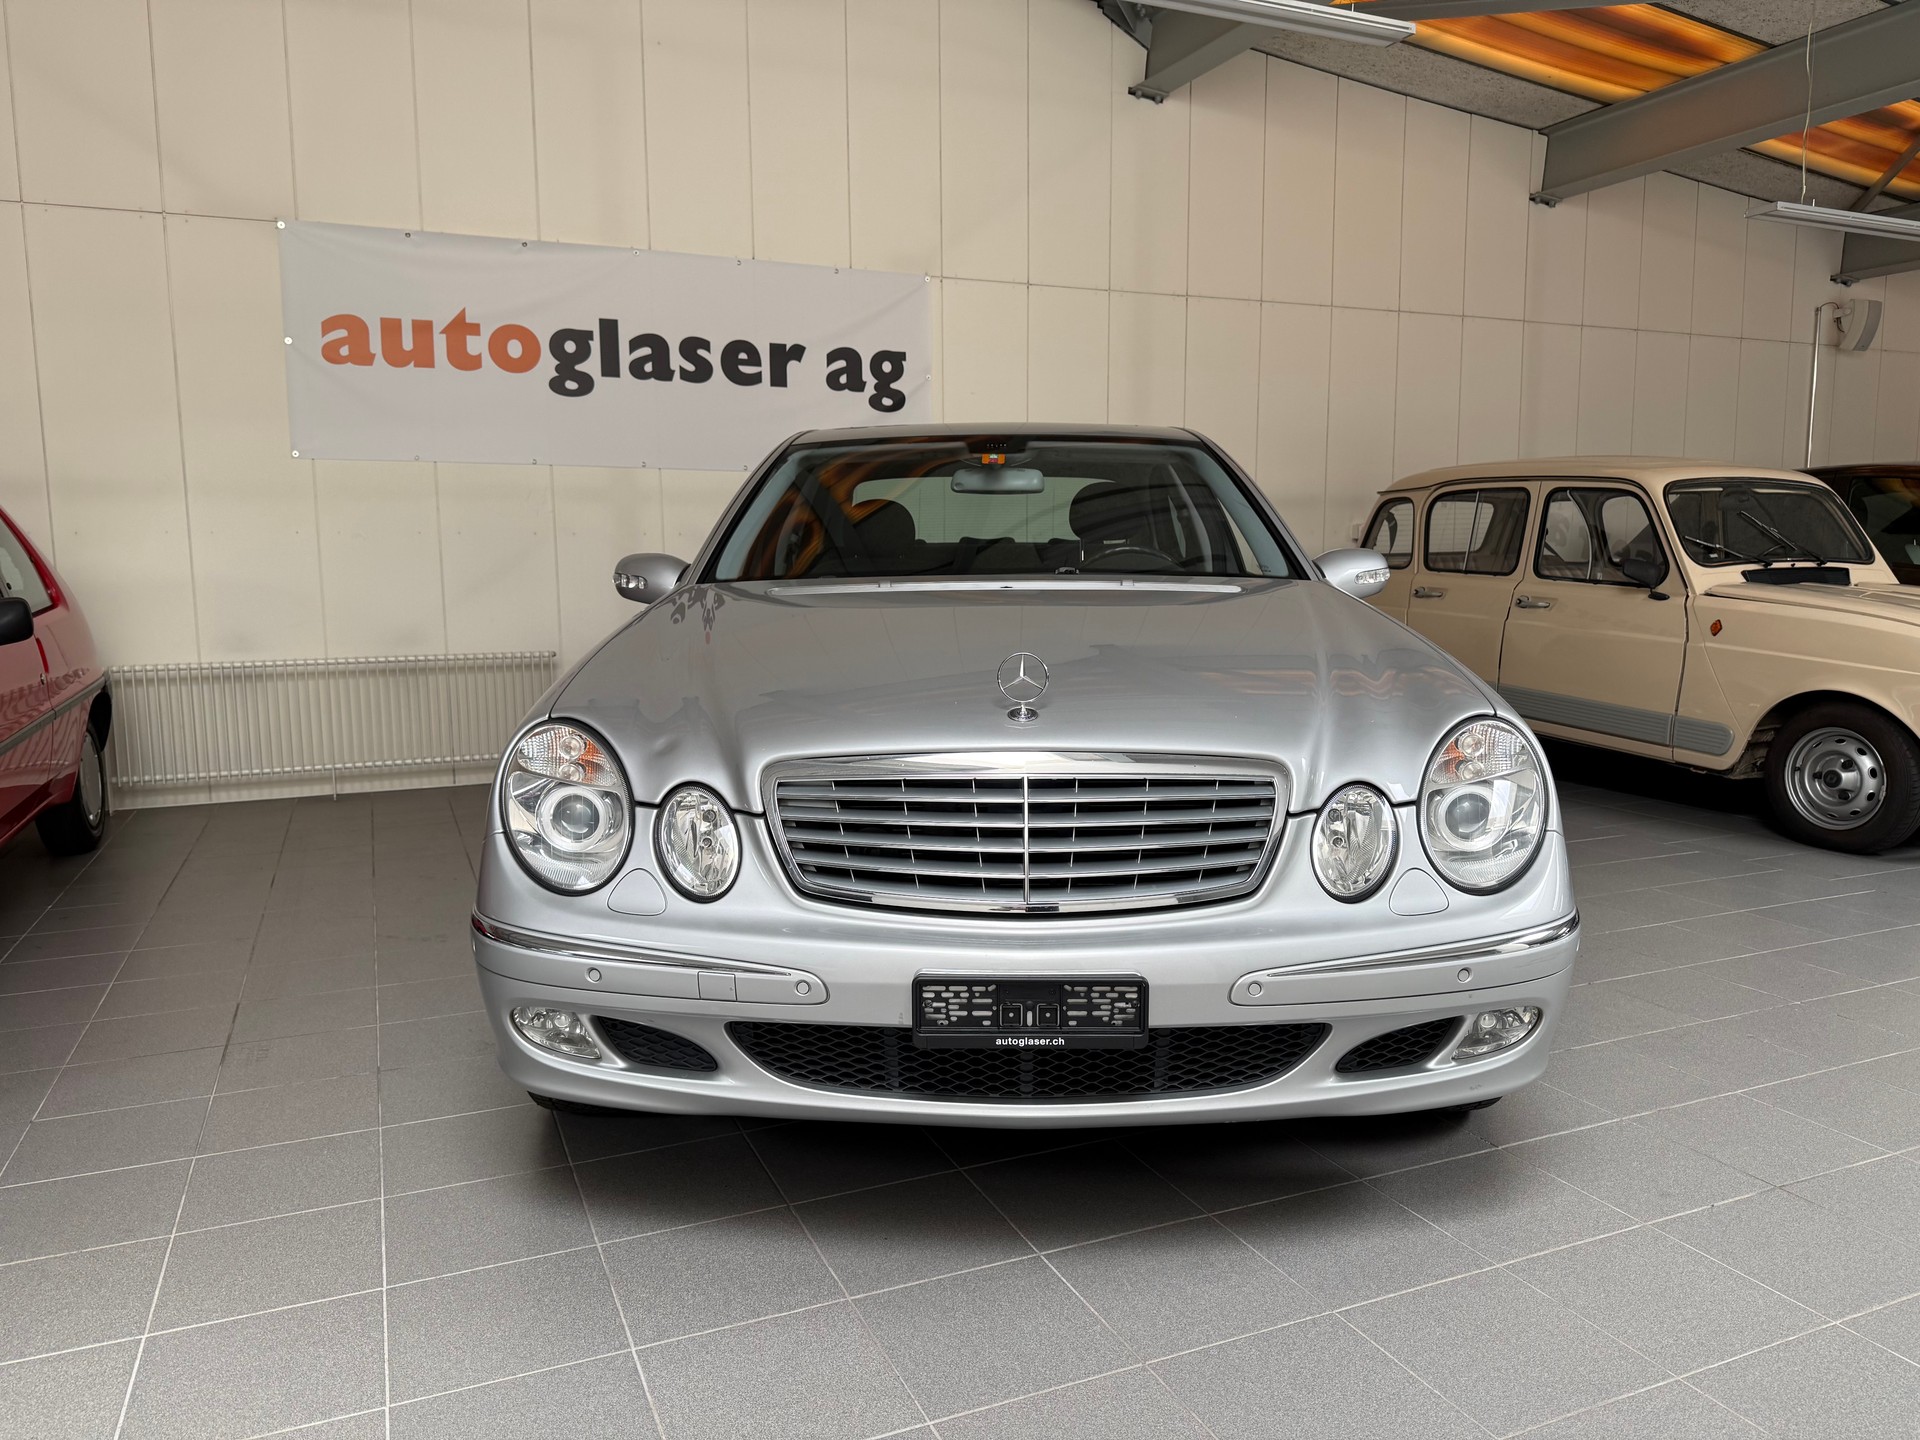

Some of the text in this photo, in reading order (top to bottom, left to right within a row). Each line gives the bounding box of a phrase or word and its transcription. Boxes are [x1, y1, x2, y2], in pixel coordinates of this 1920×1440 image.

[320, 306, 907, 413] autoglaser ag
[995, 1037, 1065, 1047] autoglaser.ch
